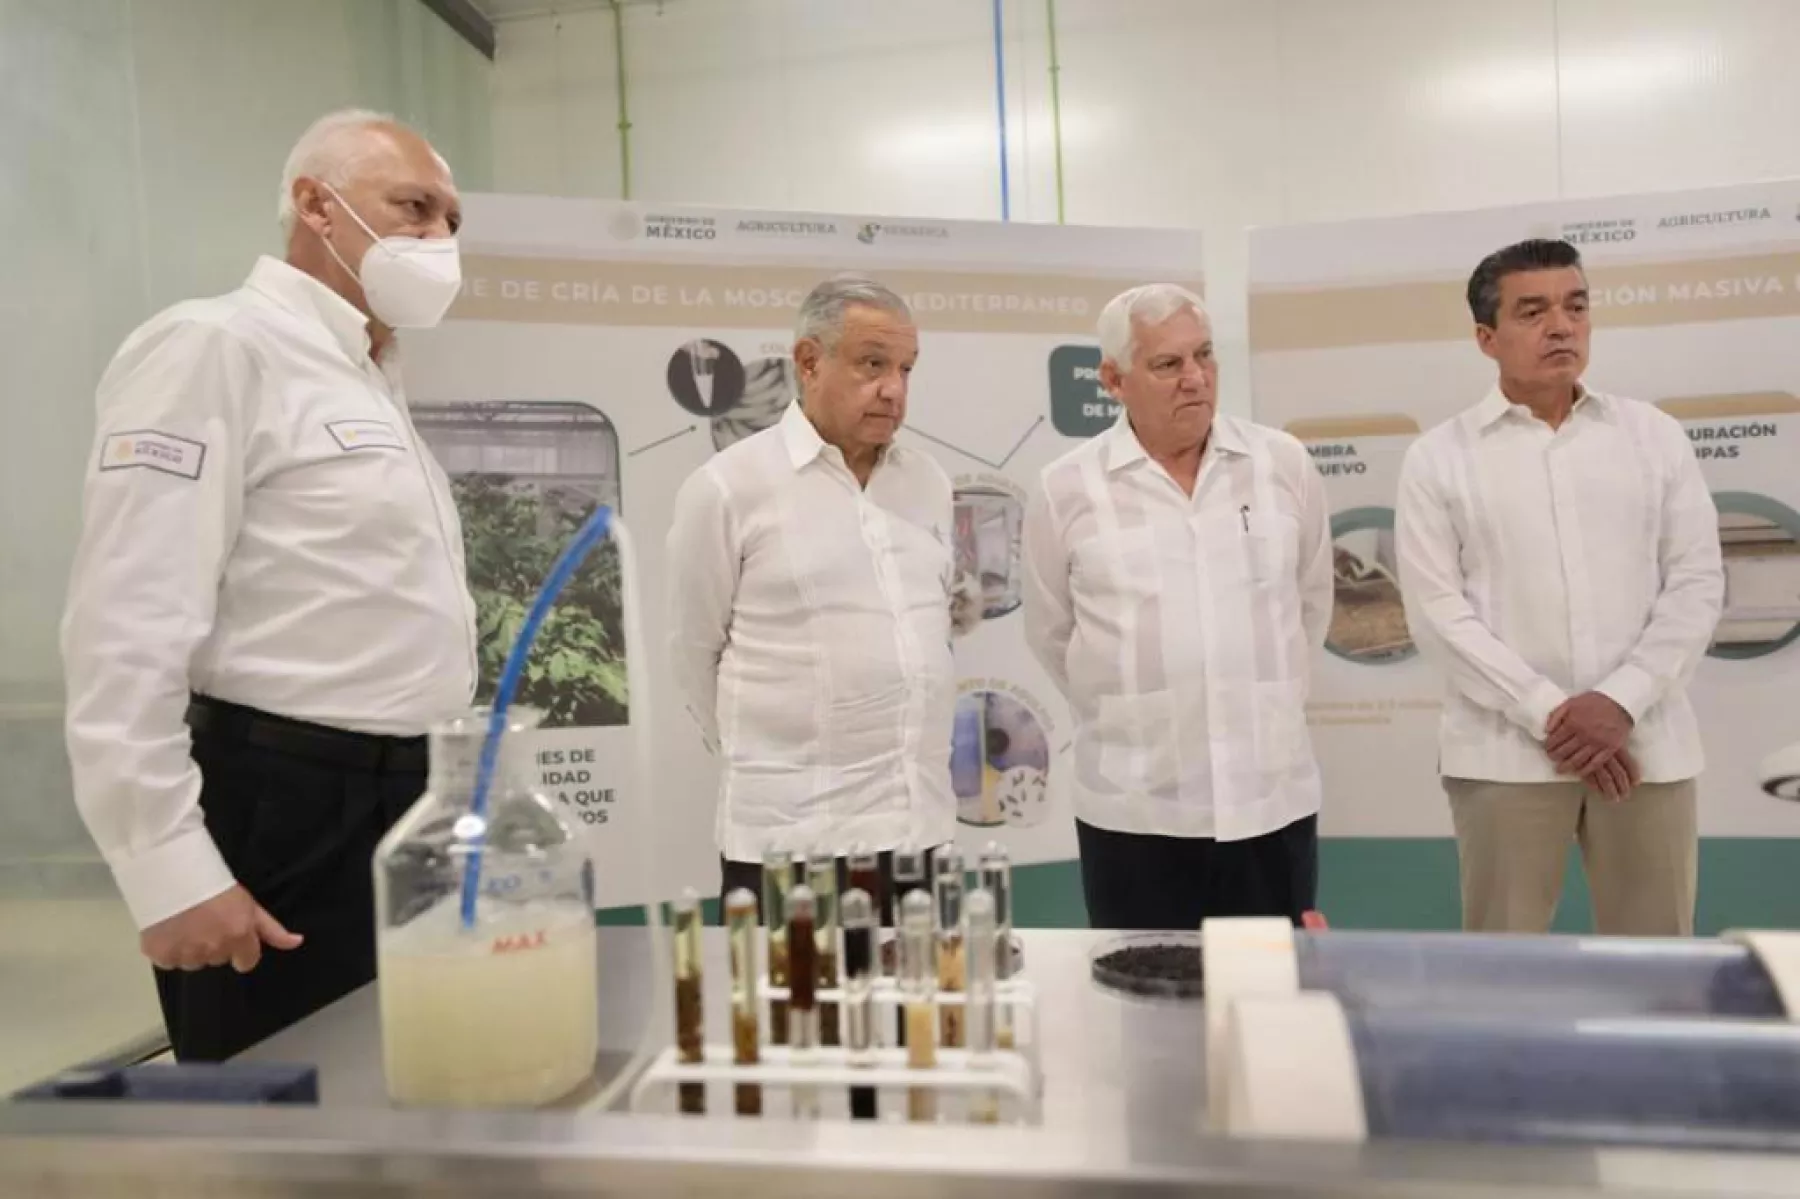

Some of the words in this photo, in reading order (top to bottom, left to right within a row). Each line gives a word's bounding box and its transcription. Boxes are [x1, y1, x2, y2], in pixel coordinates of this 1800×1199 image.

[1658, 207, 1772, 228] AGRICULTURA
[646, 224, 716, 240] MÉXICO
[735, 219, 838, 234] AGRICULTURA
[1563, 229, 1636, 244] MÉXICO
[501, 279, 541, 300] DE
[551, 279, 620, 304] CRÍA
[632, 284, 668, 305] DE
[680, 287, 714, 307] LA
[1668, 275, 1784, 303] MASIVA
[1082, 403, 1105, 417] DE
[570, 749, 597, 764] DE
[575, 788, 616, 807] QUE
